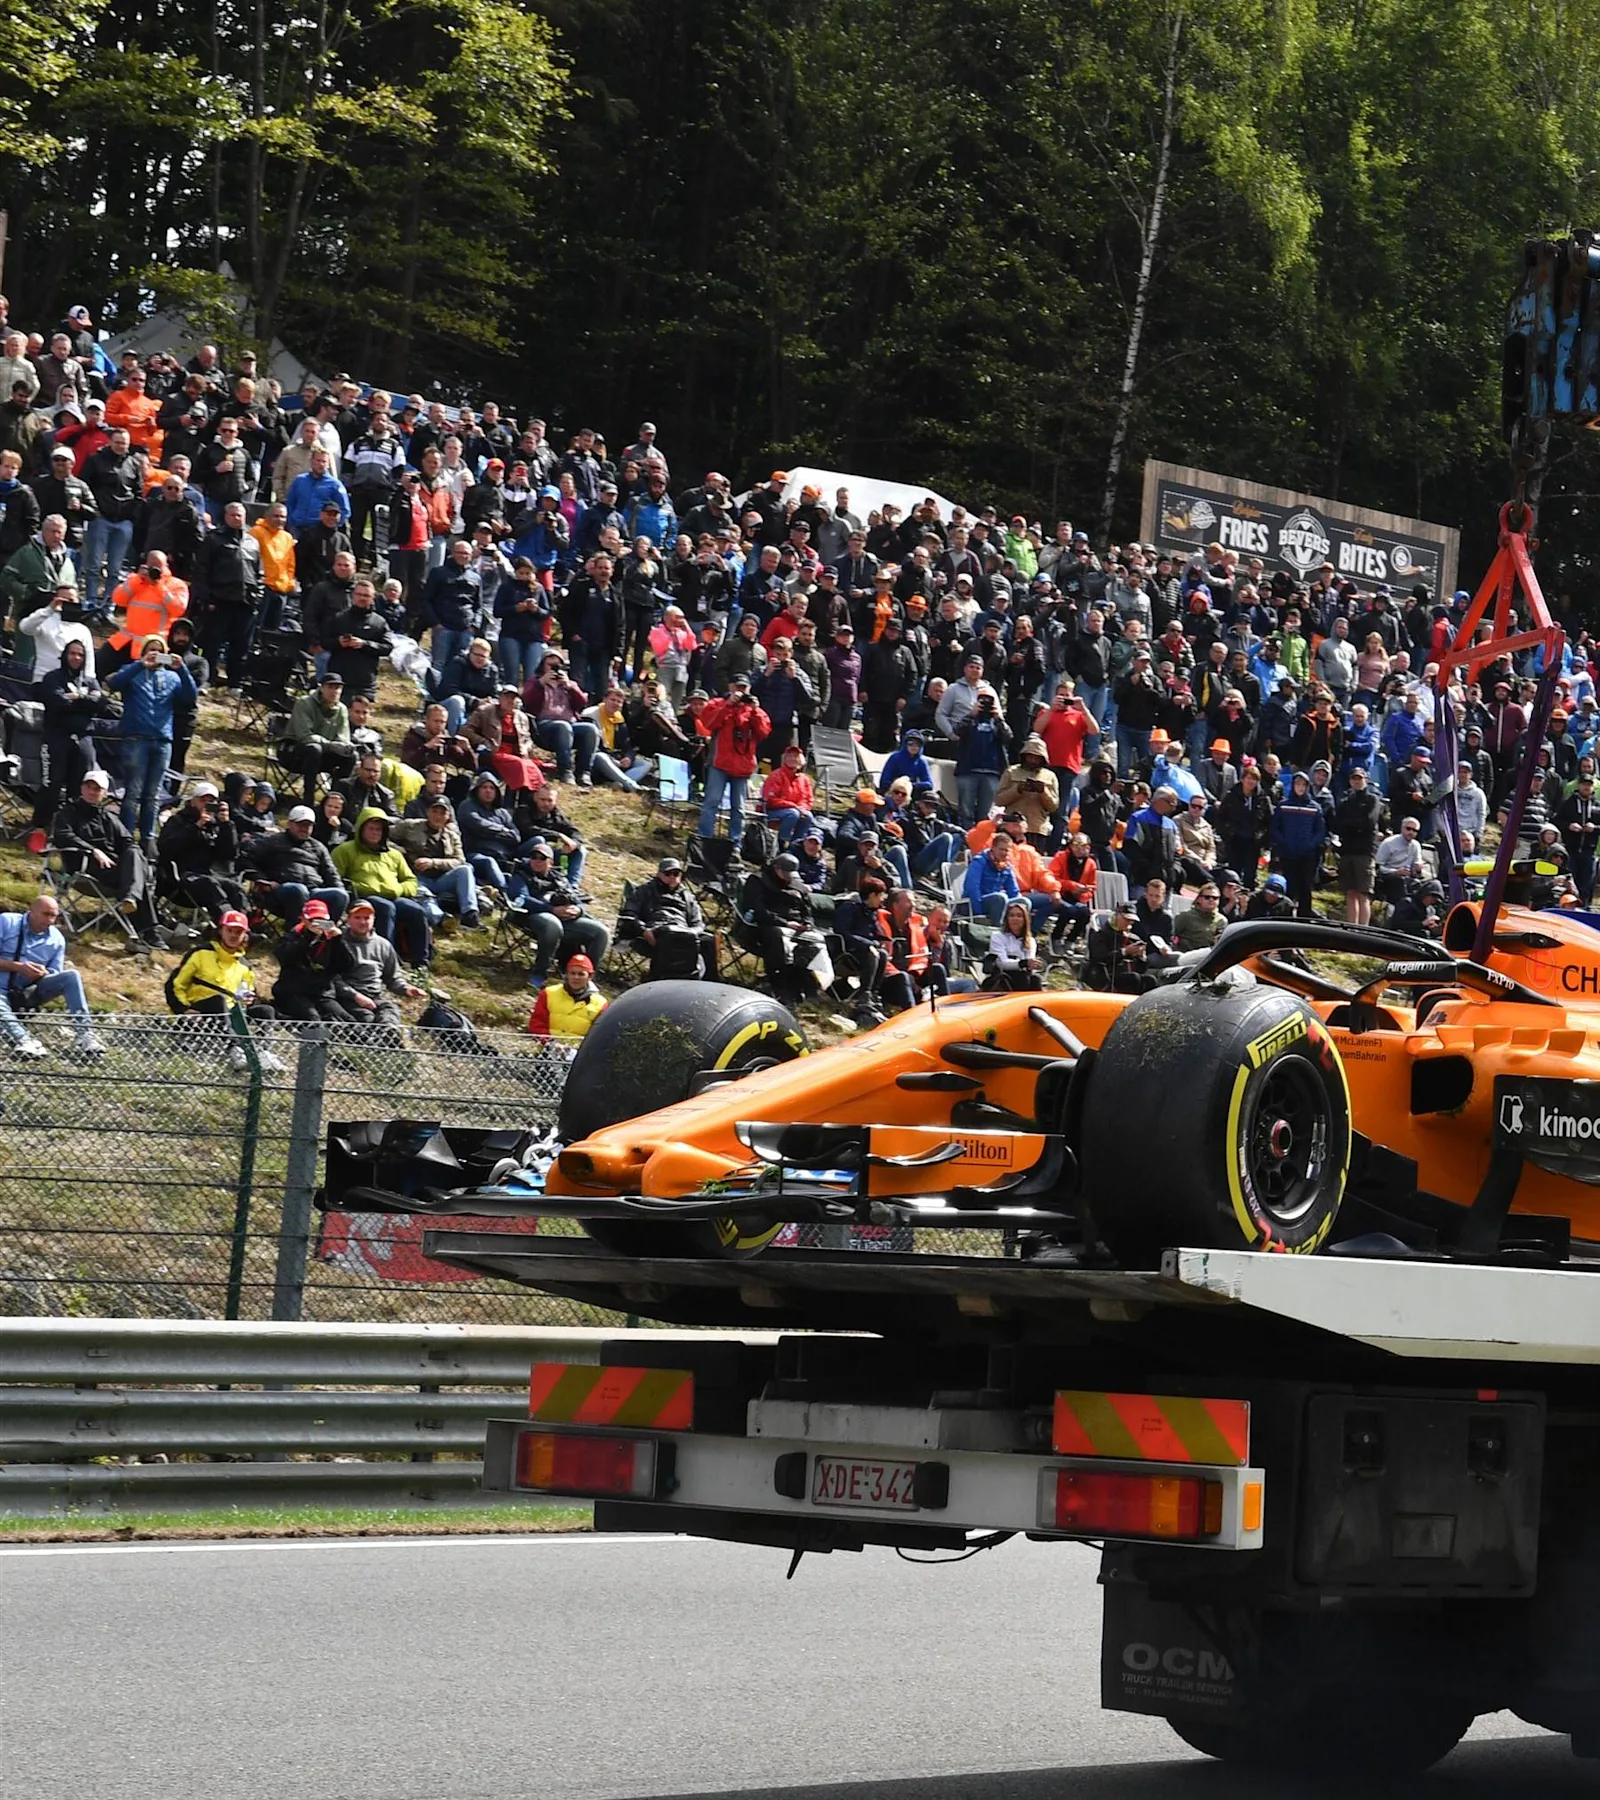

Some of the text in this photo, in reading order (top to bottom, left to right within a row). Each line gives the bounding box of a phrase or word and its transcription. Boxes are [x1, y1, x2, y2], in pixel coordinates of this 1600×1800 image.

[1219, 515, 1270, 554] FRIES
[1278, 528, 1331, 555] BEVERS
[1338, 541, 1388, 579] BITES
[760, 1021, 778, 1040] P
[1245, 1010, 1307, 1070] PIRELLI
[1121, 1672, 1153, 1686] TRUCK
[1122, 1642, 1235, 1682] OCM
